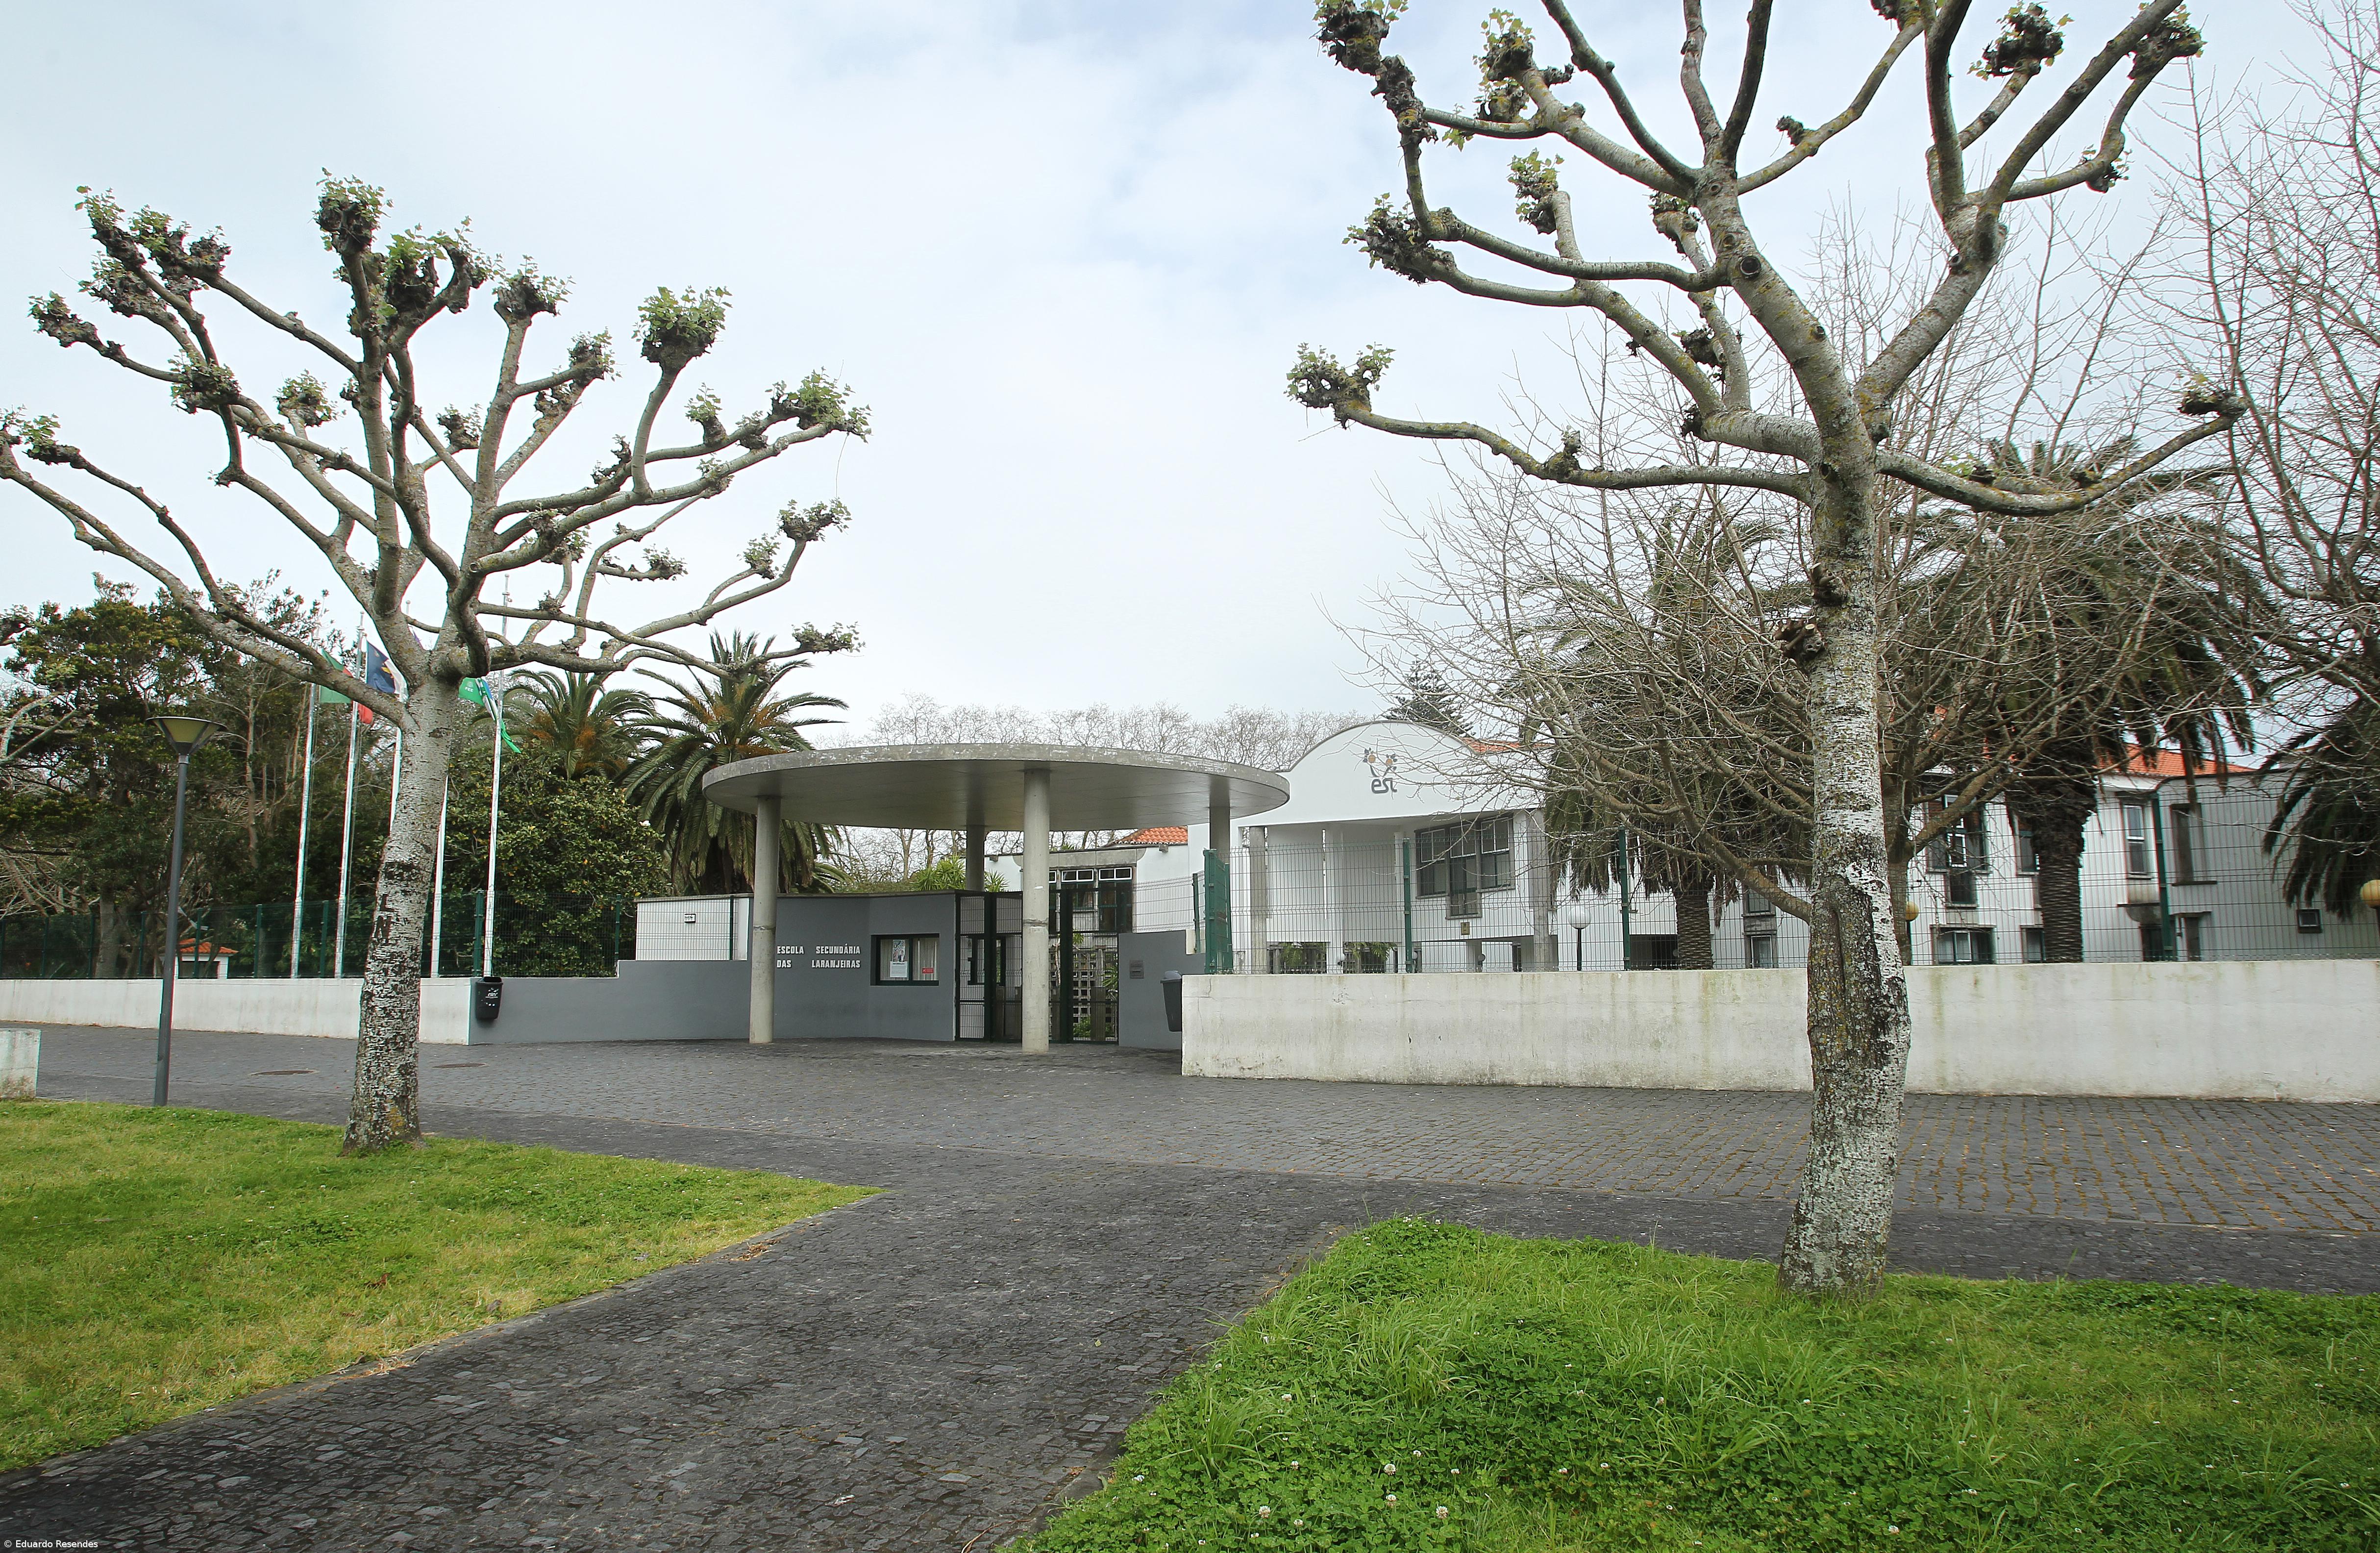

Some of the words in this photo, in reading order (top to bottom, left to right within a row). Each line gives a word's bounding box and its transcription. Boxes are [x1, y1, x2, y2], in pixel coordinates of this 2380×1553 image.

[777, 946, 804, 954] ESCOLA
[816, 943, 861, 954] SECUNDÁRIA
[777, 960, 792, 968] DAS
[812, 960, 861, 968] LARANJEIRAS
